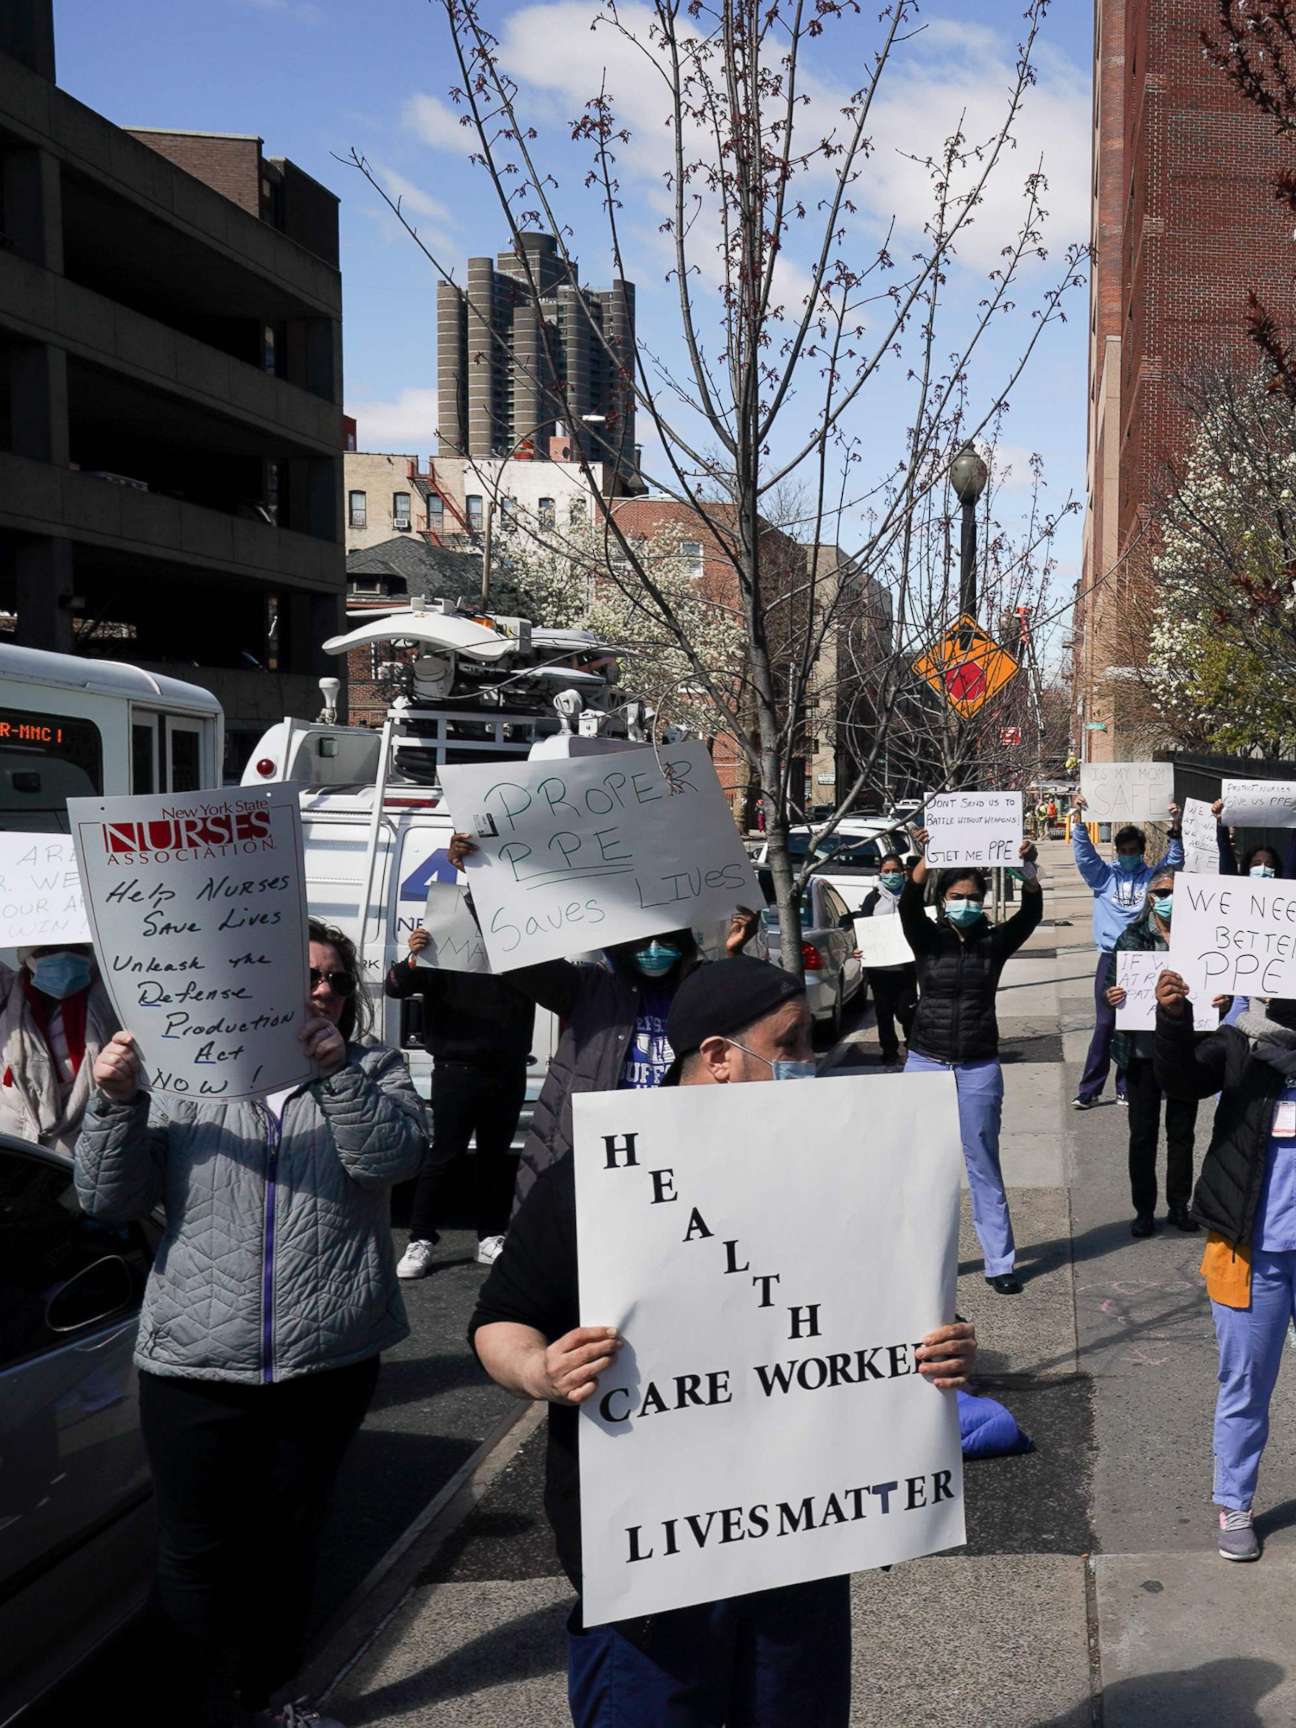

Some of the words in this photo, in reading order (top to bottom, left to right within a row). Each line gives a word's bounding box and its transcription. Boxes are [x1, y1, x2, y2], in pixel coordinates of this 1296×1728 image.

[161, 804, 199, 821] New
[199, 801, 232, 817] York
[232, 798, 269, 814] State
[484, 760, 698, 831] PROPER
[1005, 798, 1016, 807] TO
[1094, 783, 1167, 816] SAFE
[1269, 796, 1294, 807] PPE
[103, 811, 272, 853] NURSES
[107, 838, 276, 866] ASSOCIATION
[498, 826, 633, 882] PPE
[965, 850, 984, 862] ME
[988, 839, 1014, 861] PPE
[400, 847, 460, 902] 4
[105, 878, 177, 909] Help
[1187, 885, 1233, 915] WE
[1196, 951, 1287, 994] PPE
[137, 980, 253, 1006] Defense
[194, 1040, 244, 1064] Act
[599, 1369, 734, 1424] CARE
